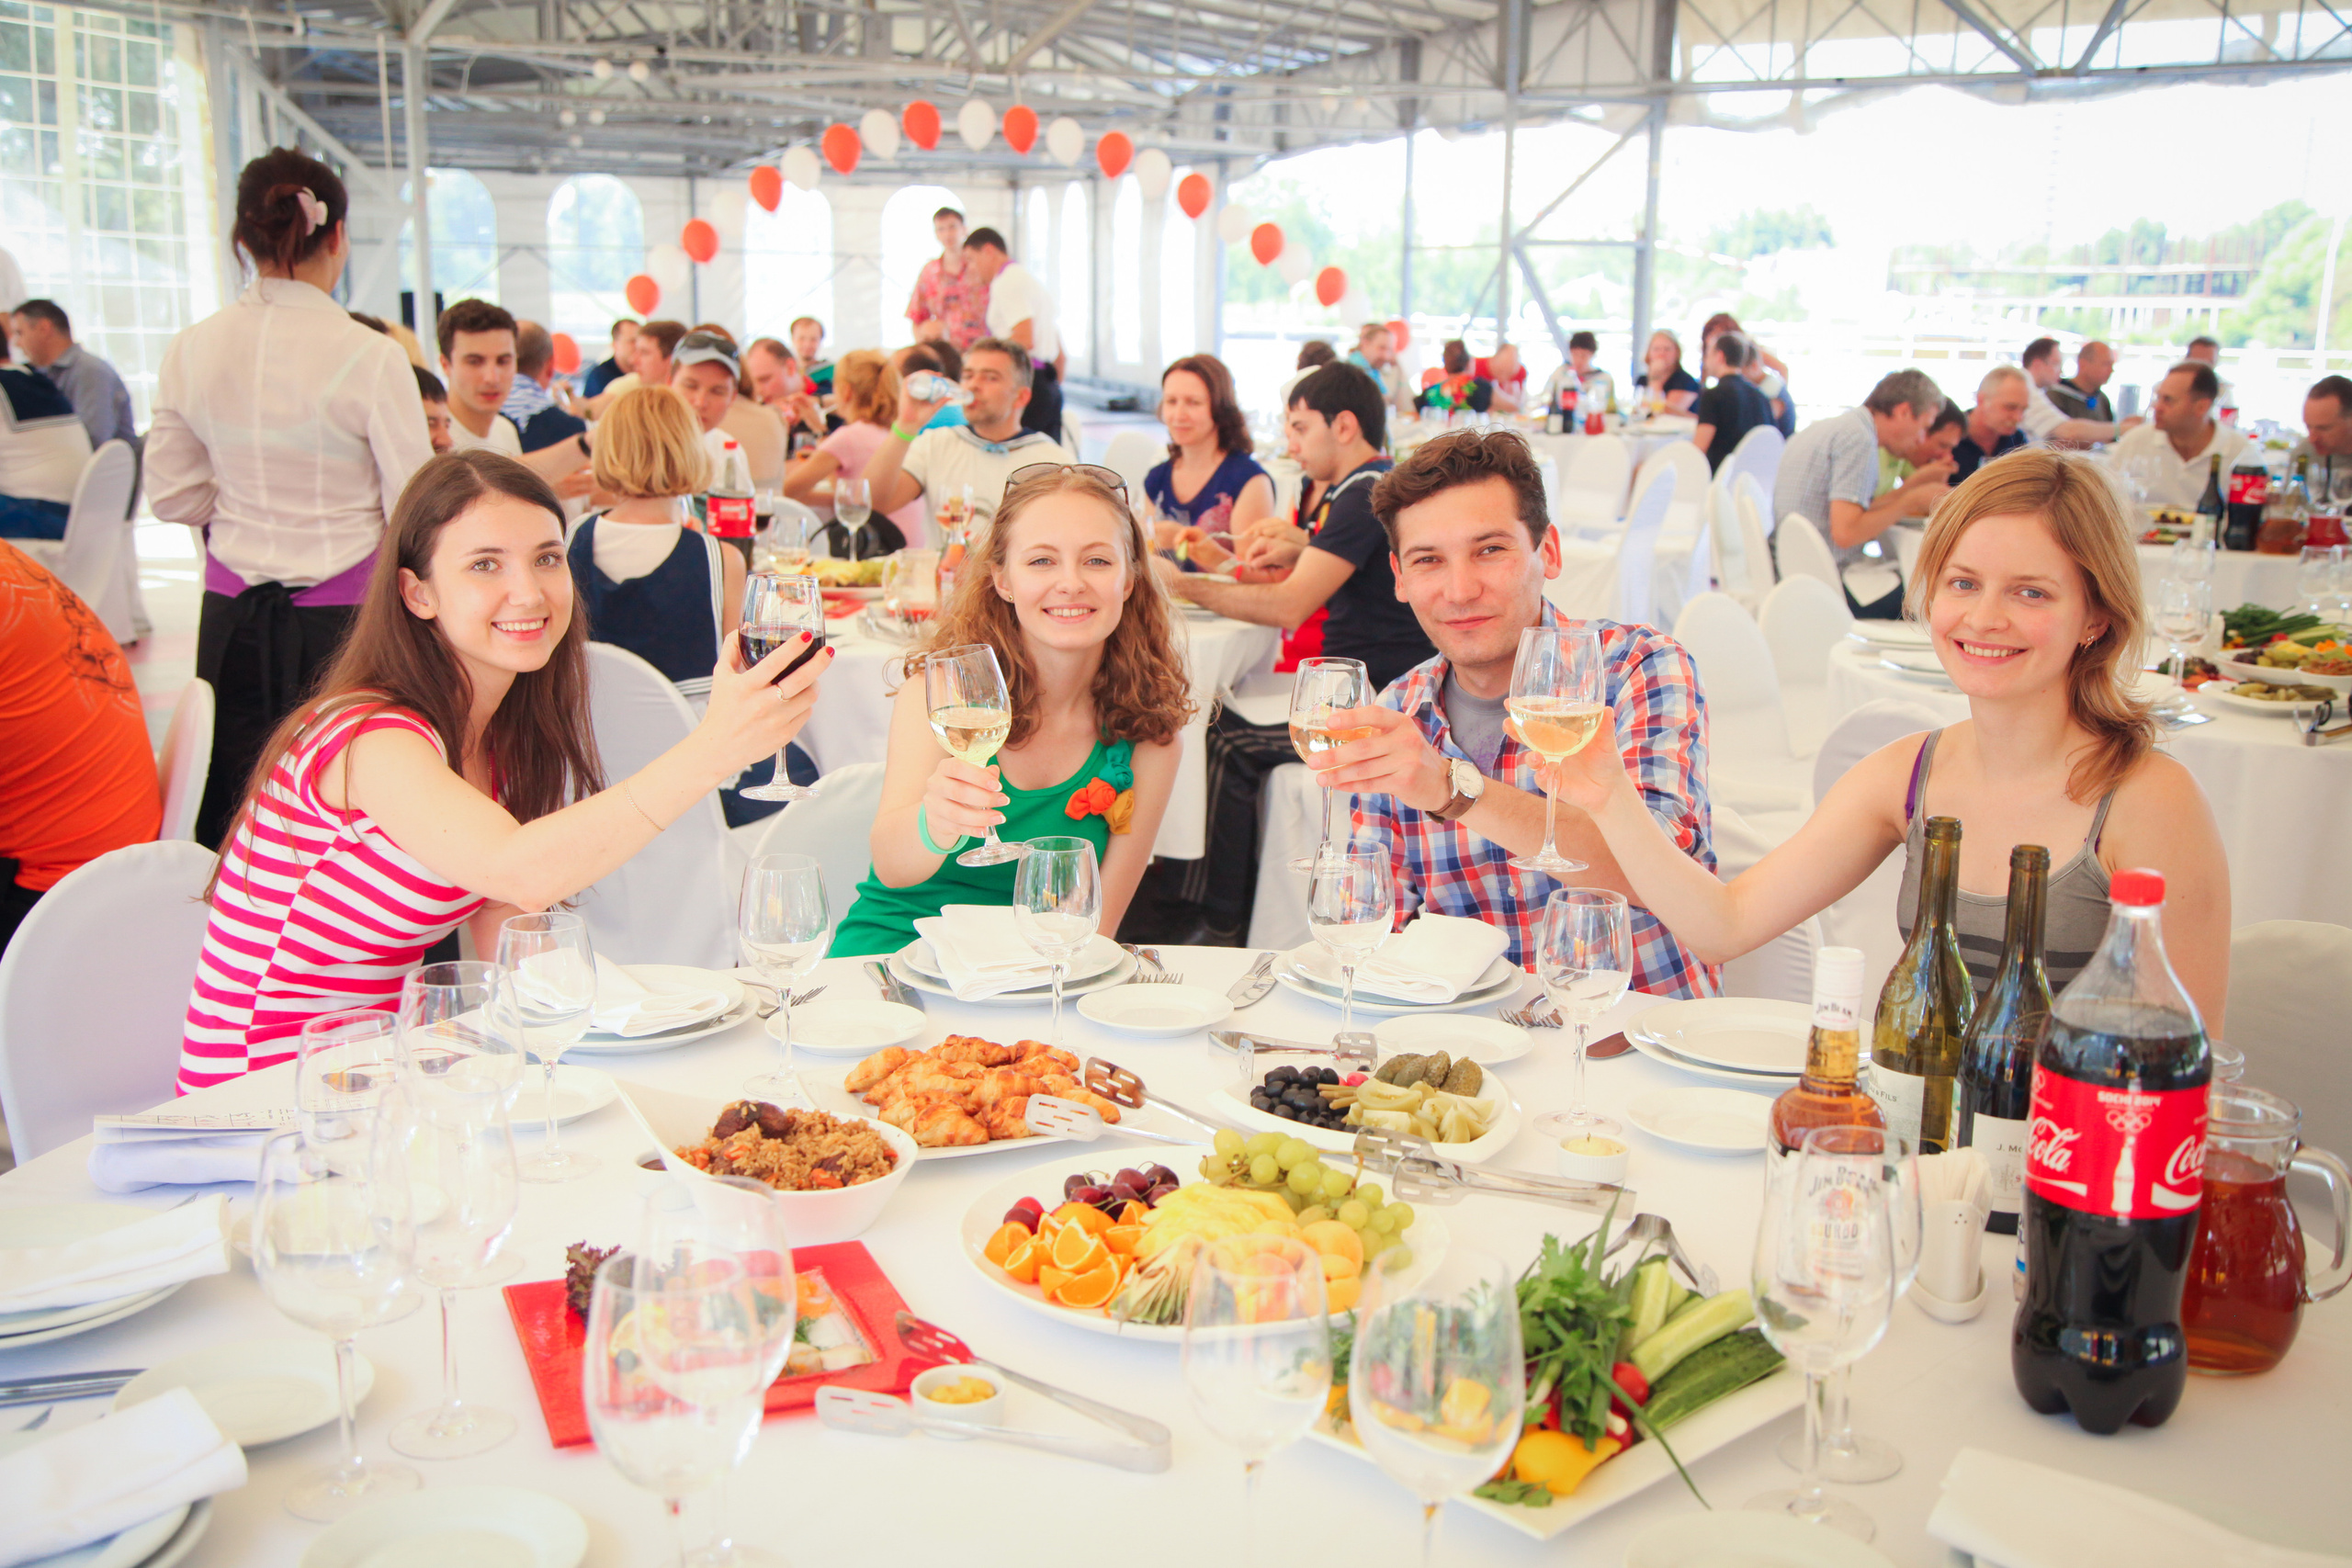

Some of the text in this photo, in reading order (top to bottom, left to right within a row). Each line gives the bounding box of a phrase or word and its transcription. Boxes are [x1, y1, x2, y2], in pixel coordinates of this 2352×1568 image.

[1880, 1090, 1897, 1102] FILS
[2098, 1090, 2162, 1107] SOCHI 2014
